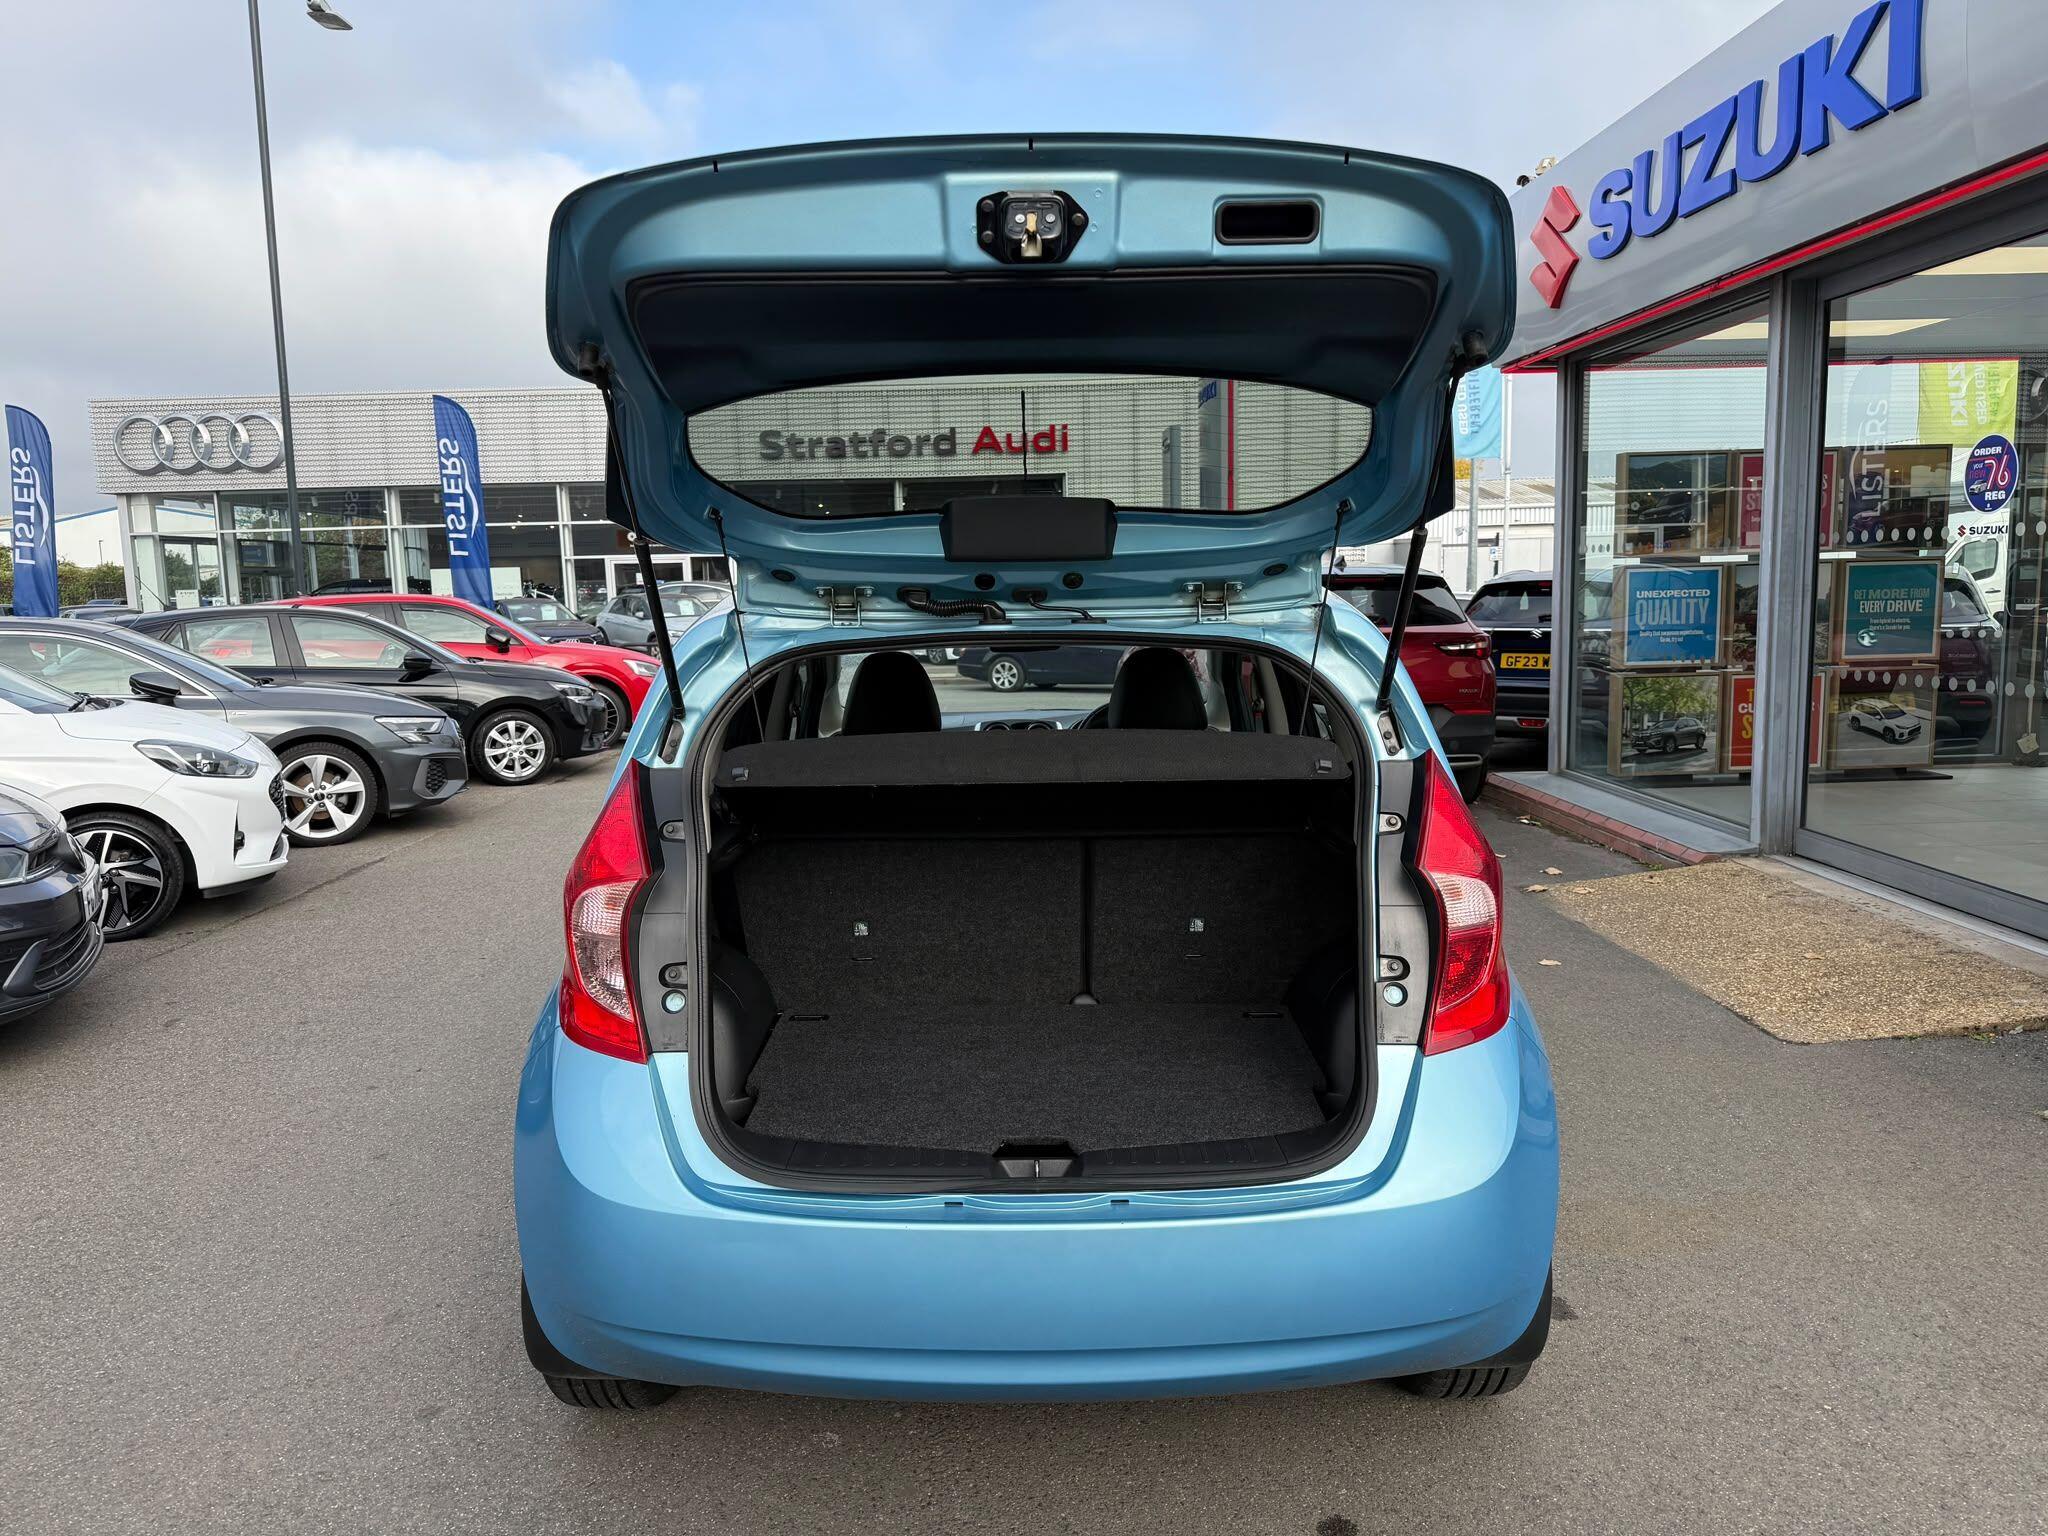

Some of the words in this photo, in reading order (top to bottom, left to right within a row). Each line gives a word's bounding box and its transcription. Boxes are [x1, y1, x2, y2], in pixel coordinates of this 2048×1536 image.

[1588, 0, 1925, 260] SUZUKI
[758, 426, 957, 460] Stratford
[972, 424, 1069, 455] Audi
[1974, 446, 2002, 457] ORDER
[1985, 454, 2010, 490] 76
[1984, 490, 2006, 501] REG
[1969, 525, 2008, 536] SUZUKI
[1636, 589, 1711, 599] UNEXPECTED
[1854, 589, 1867, 600] GET
[1868, 588, 1909, 600] MORE
[1910, 588, 1930, 599] FROM
[1860, 600, 1885, 613] EVERY
[1887, 599, 1923, 613] DRIVE
[1635, 598, 1711, 630] QUALITY
[1506, 655, 1539, 667] GF23
